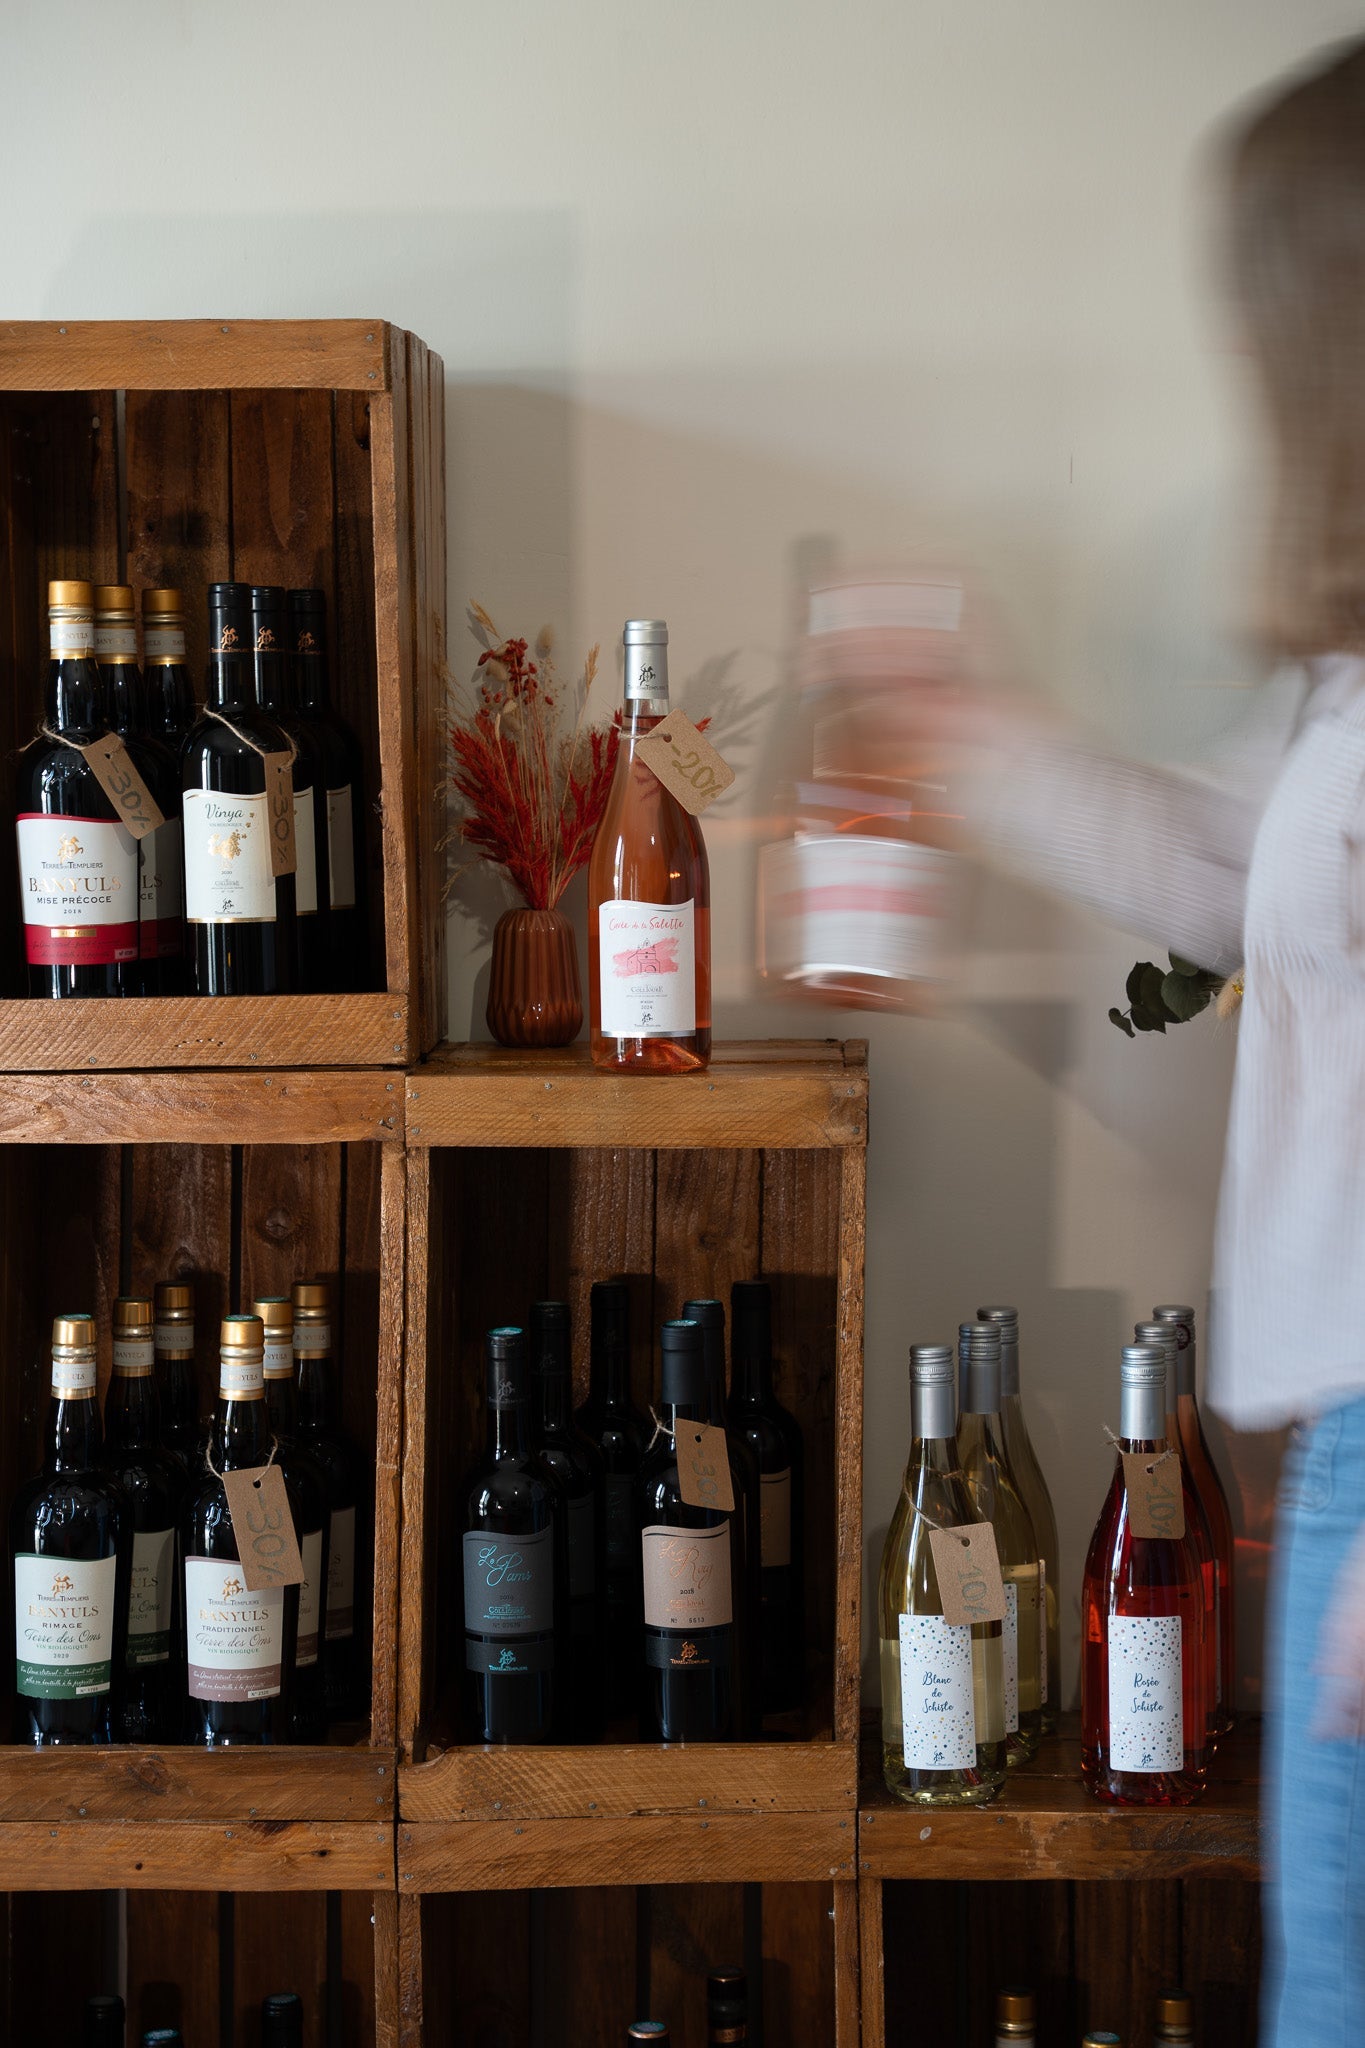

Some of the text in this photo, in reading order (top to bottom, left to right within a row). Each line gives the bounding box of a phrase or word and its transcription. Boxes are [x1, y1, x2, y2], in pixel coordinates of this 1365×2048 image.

[671, 743, 723, 798] -20%
[107, 761, 151, 829] -30%
[204, 803, 244, 822] Vinya
[273, 781, 290, 863] -30%
[41, 861, 104, 869] TERRES TEMPLIERS
[29, 876, 122, 892] BANYULS
[62, 896, 112, 904] PRÉCOCE
[649, 916, 685, 930] Salette
[1146, 1475, 1176, 1537] -10%
[246, 1490, 286, 1581] -30%
[478, 1545, 498, 1569] Le
[680, 1587, 695, 1595] 2018
[957, 1550, 991, 1619] -10%
[28, 1605, 99, 1618] BANYULS
[199, 1609, 269, 1621] BANYULS
[24, 1628, 101, 1643] Terre des Oms
[195, 1632, 272, 1647] Terre des Oms
[922, 1671, 953, 1686] Blanc
[1133, 1672, 1160, 1688] Rosée
[932, 1688, 943, 1697] de
[1142, 1690, 1152, 1698] de
[922, 1698, 955, 1713] Schiste
[1131, 1697, 1164, 1713] Schiste
